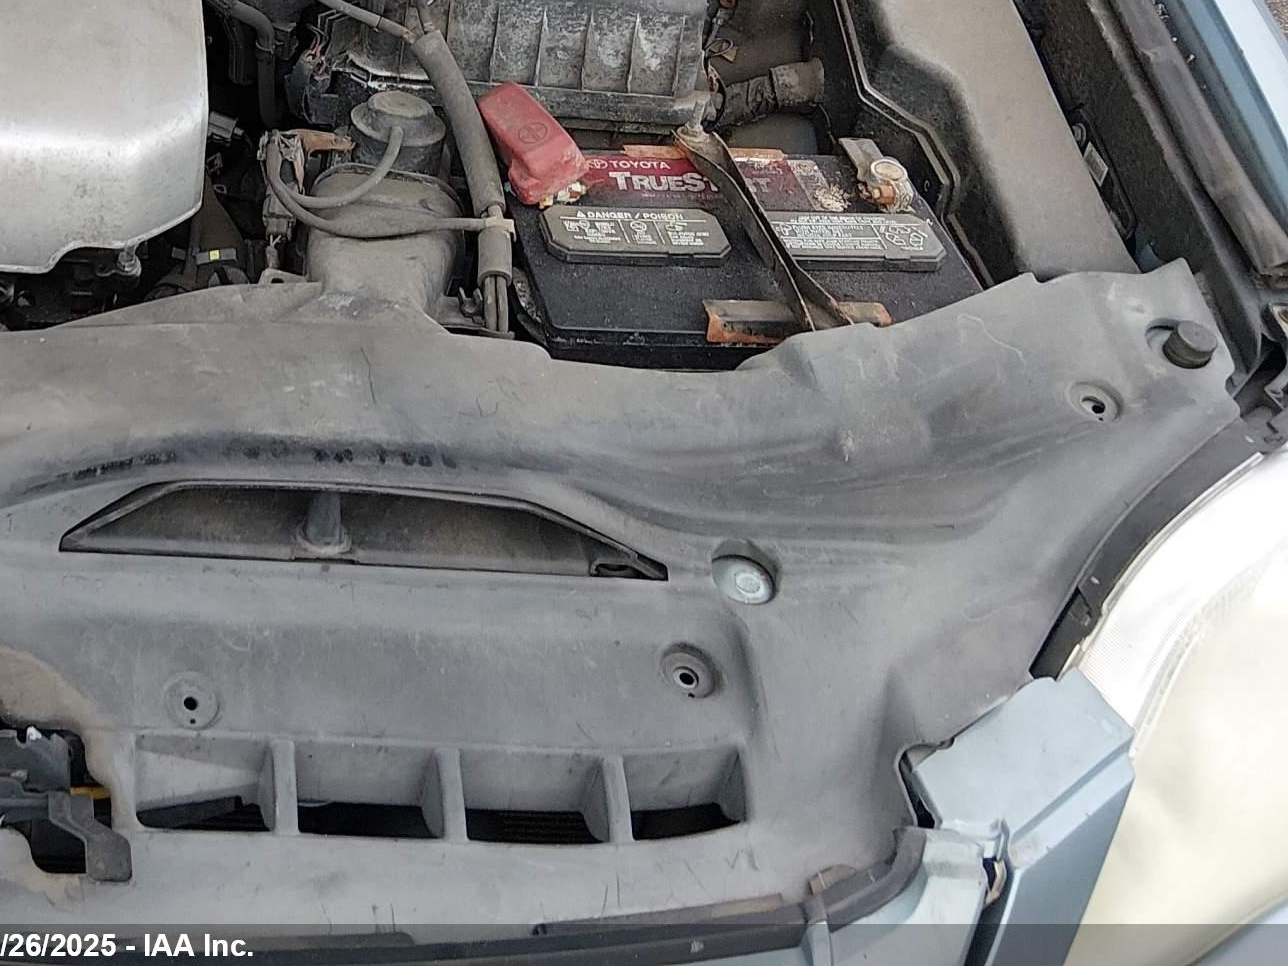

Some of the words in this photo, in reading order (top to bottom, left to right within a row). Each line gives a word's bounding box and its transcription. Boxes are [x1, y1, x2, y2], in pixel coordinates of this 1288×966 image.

[609, 159, 671, 170] TOYOTA
[586, 210, 633, 220] DANGER
[642, 212, 684, 221] POISON
